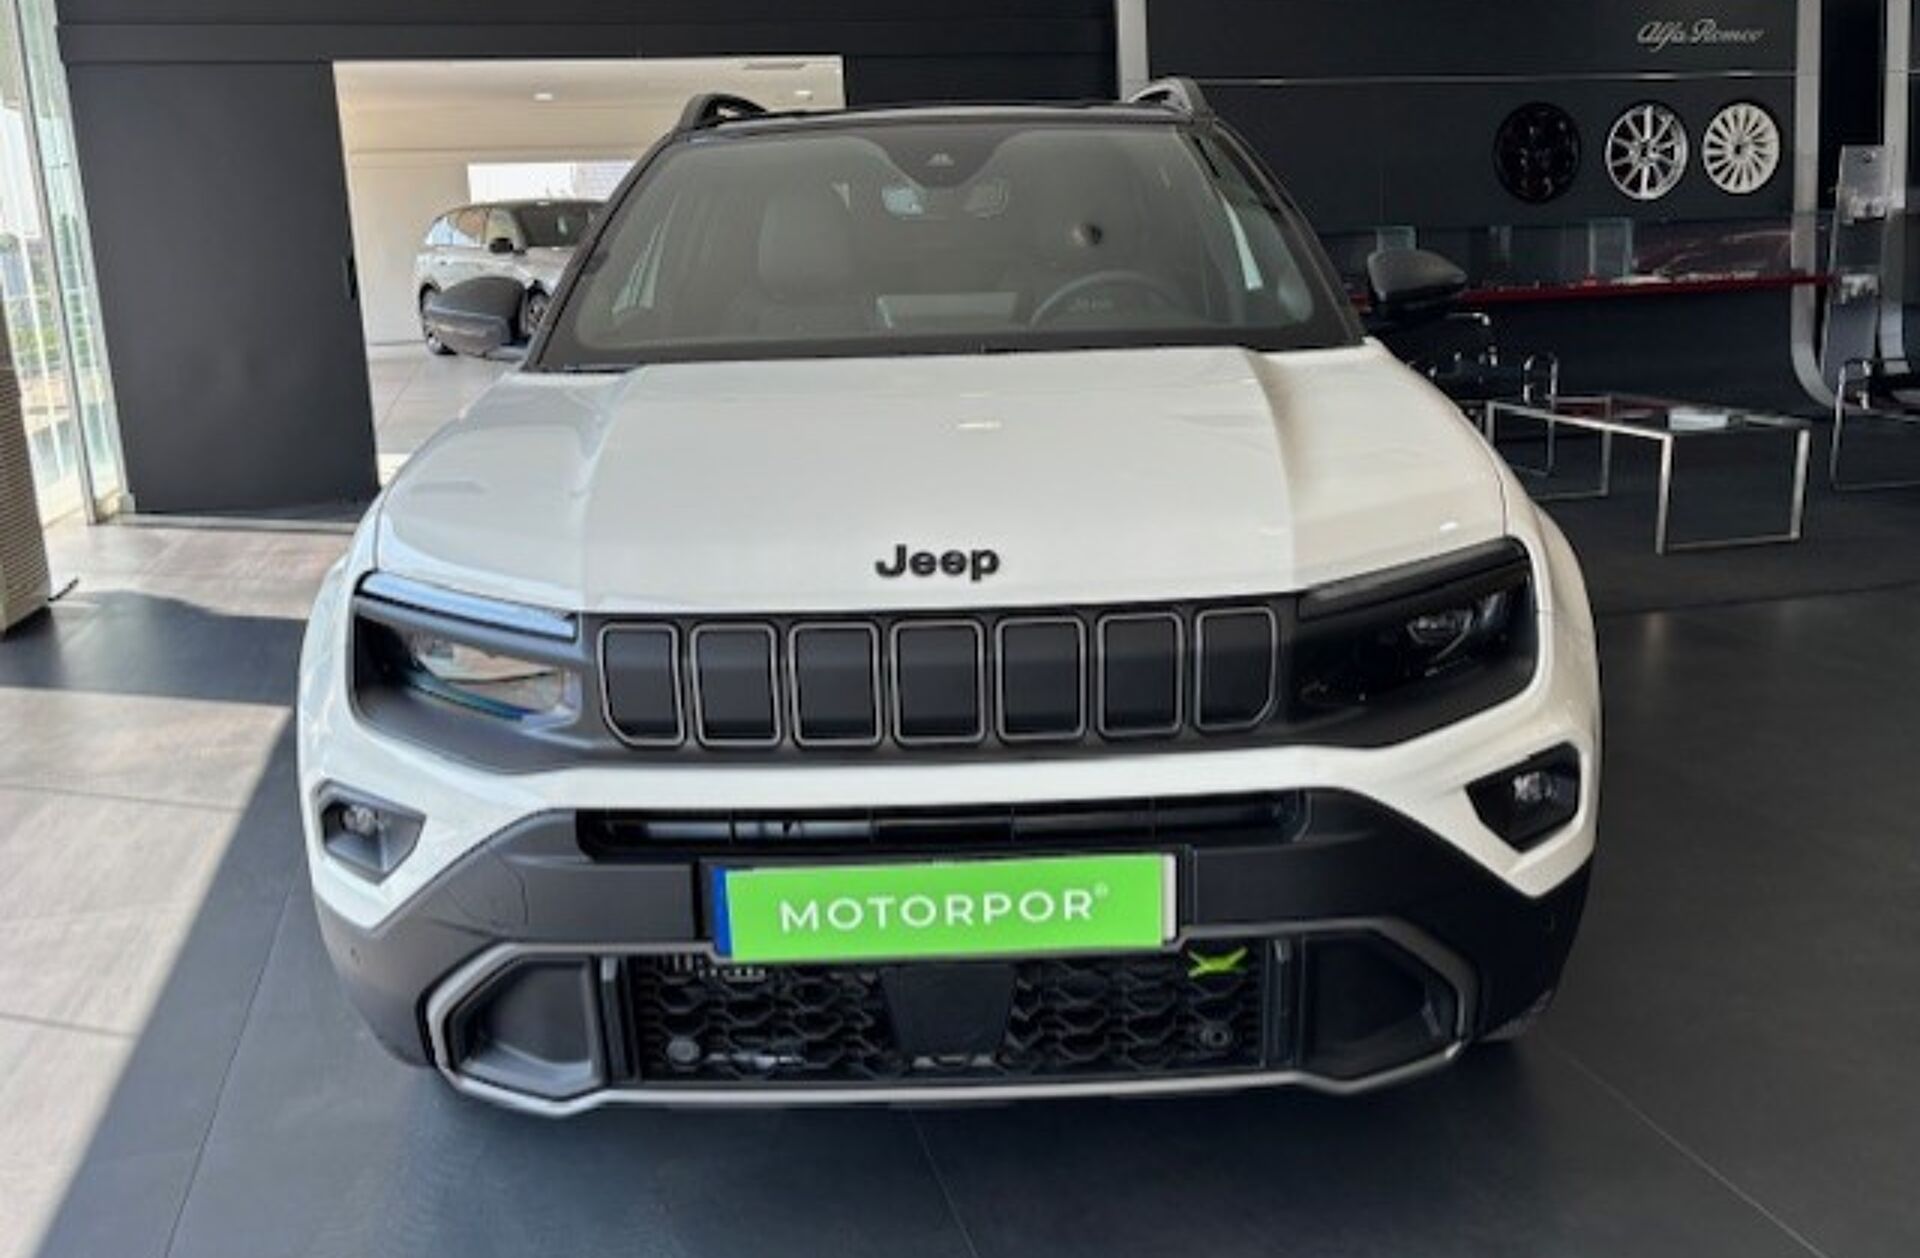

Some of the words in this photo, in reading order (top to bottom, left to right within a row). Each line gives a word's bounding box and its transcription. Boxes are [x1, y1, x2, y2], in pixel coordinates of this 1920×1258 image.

[1637, 21, 1685, 52] Alfa
[1691, 18, 1765, 43] Romeo
[875, 544, 1000, 582] Jeep
